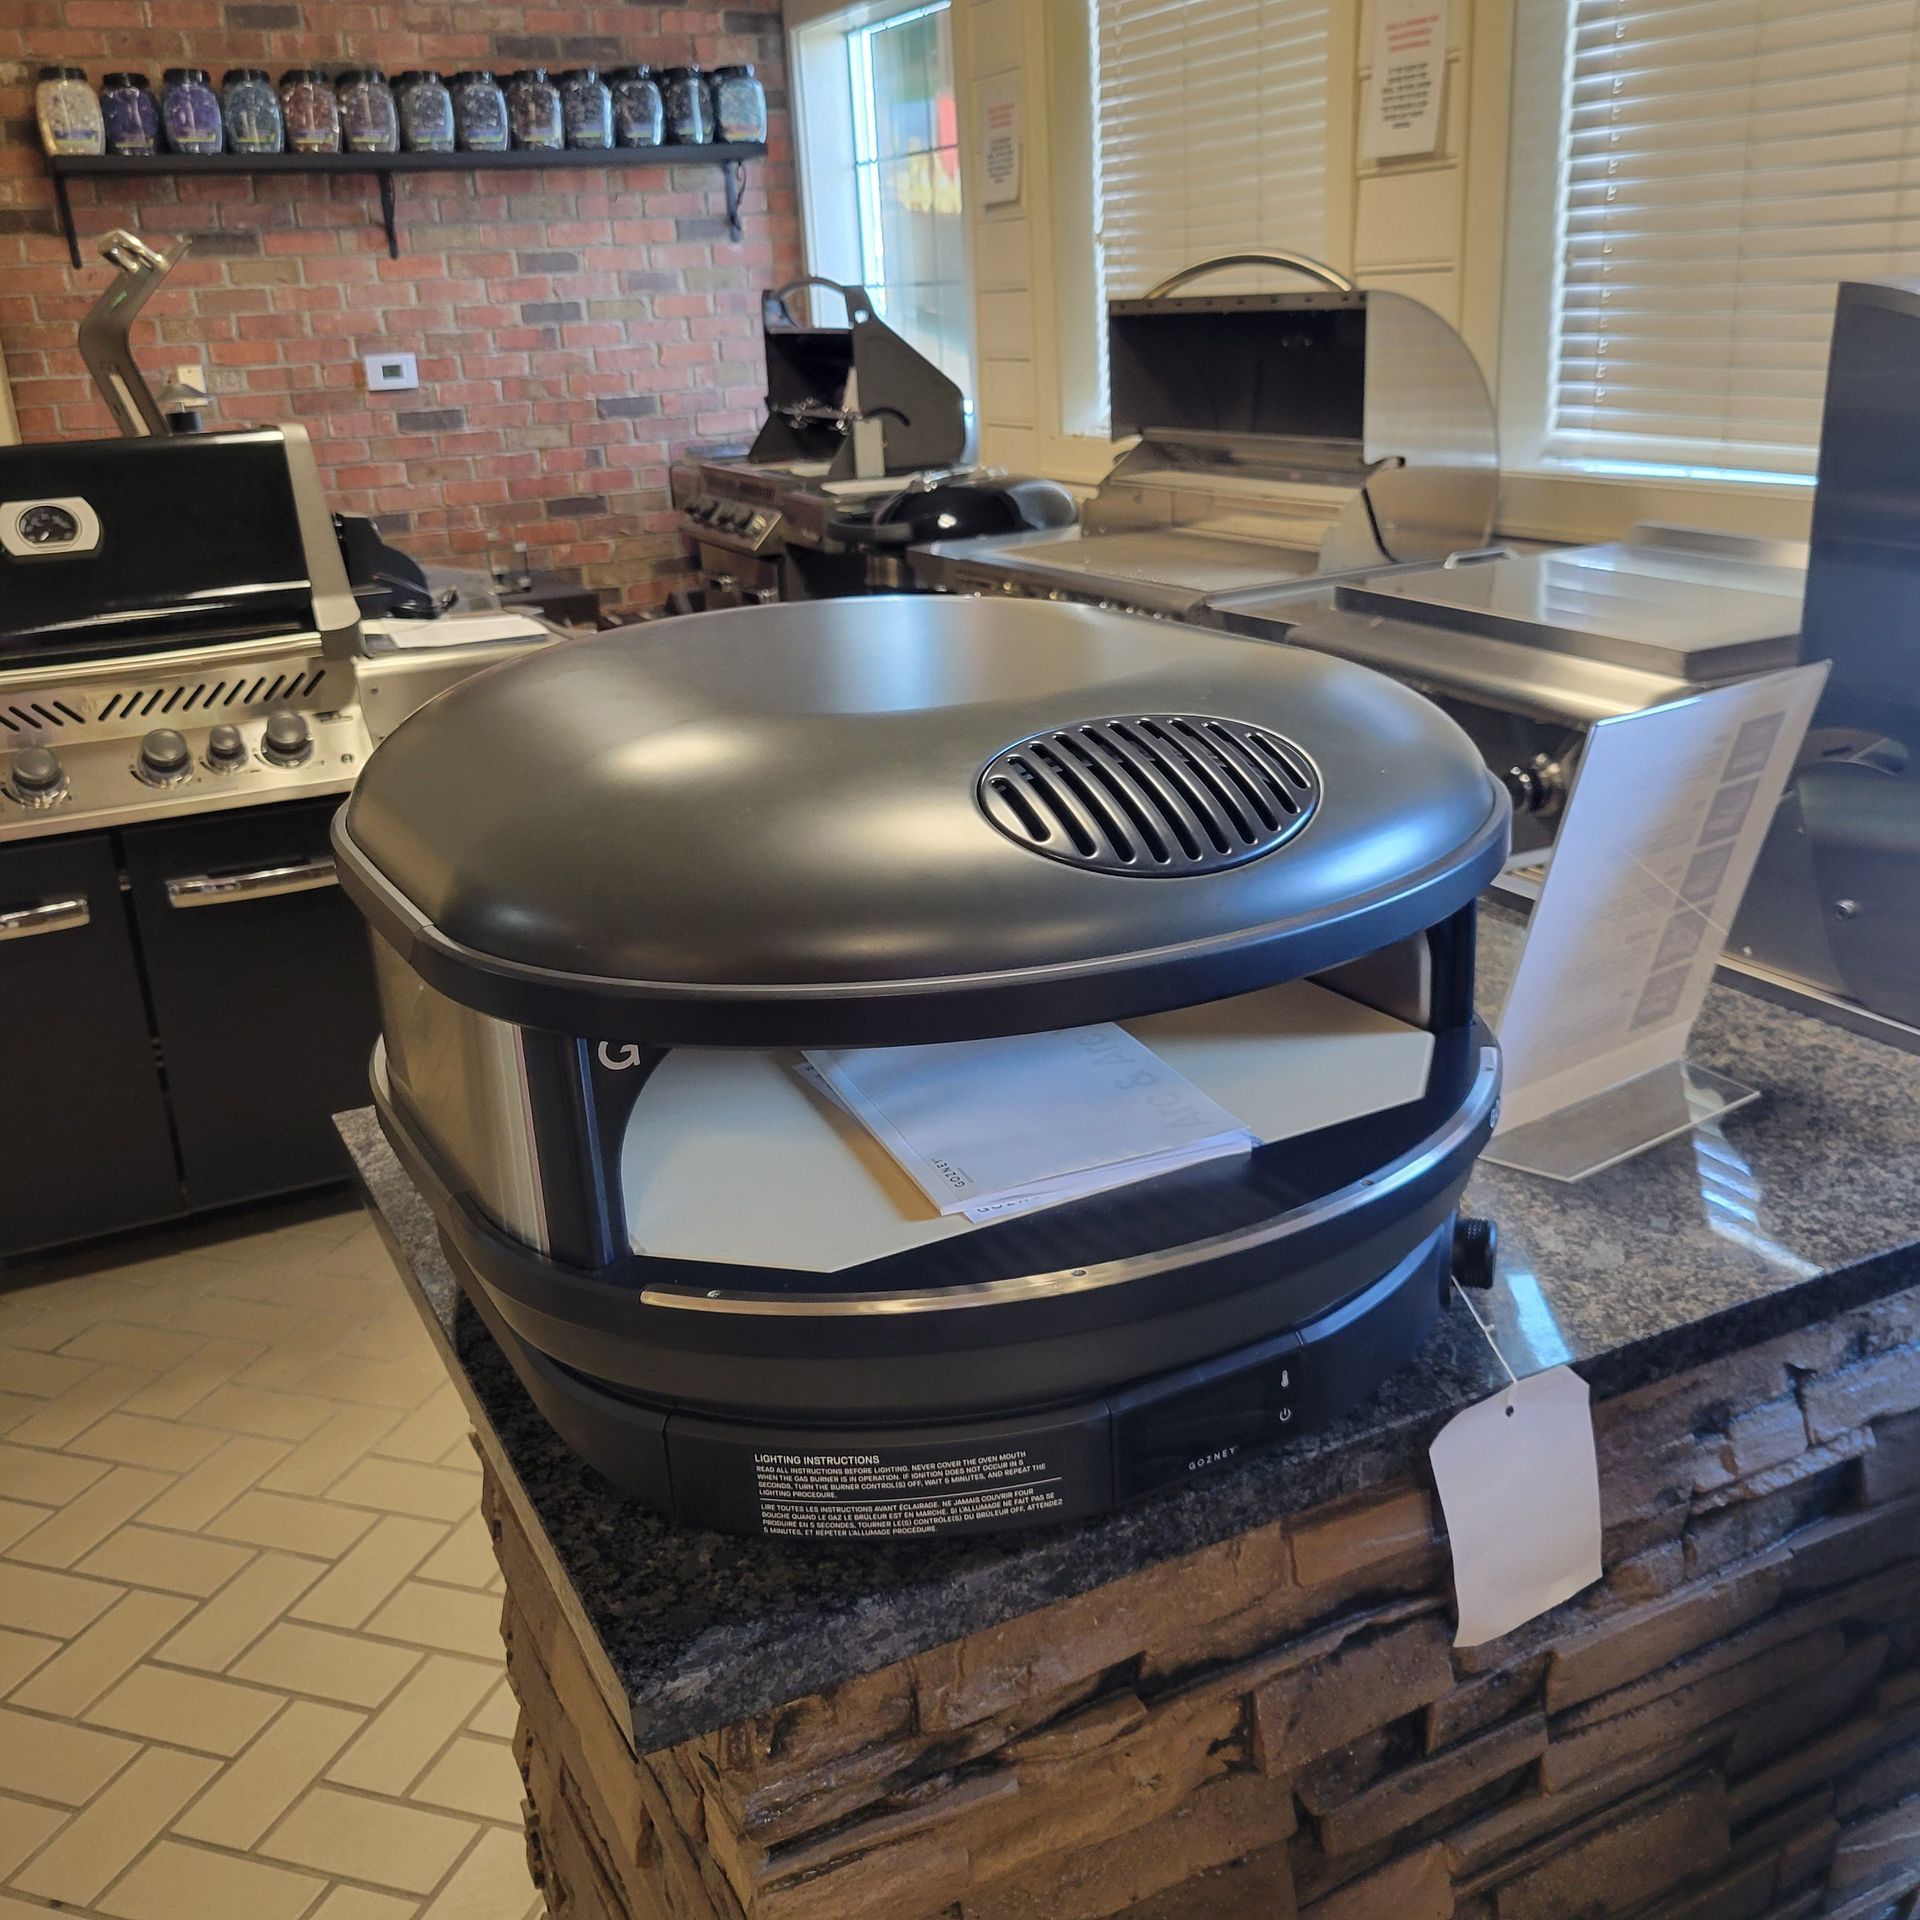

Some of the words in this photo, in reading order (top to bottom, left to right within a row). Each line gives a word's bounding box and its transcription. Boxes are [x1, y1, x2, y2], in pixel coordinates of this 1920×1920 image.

[597, 1040, 640, 1070] G
[934, 1158, 965, 1188] GOZNEY
[754, 1454, 800, 1464] LIGHTING
[803, 1455, 880, 1465] INSTRUCTIONS
[911, 1463, 935, 1471] NEVER
[937, 1460, 961, 1469] COVER
[963, 1458, 976, 1466] THE
[978, 1455, 997, 1464] OVEN
[999, 1451, 1026, 1461] MOUTH
[1188, 1446, 1237, 1470] GOZNEY
[861, 1481, 906, 1489] CONTROL(S)
[925, 1478, 942, 1486] WAIT
[1005, 1466, 1031, 1475] REPEAT
[911, 1470, 943, 1479] IGNITION
[945, 1468, 965, 1476] DOES
[966, 1465, 981, 1473] NOT
[983, 1461, 1008, 1471] OCCUR
[759, 1489, 791, 1497] LIGHTING
[777, 1504, 804, 1512] TOUTES
[954, 1496, 980, 1506] JAMAIS
[981, 1492, 1013, 1502] COUVRIR
[1014, 1488, 1034, 1497] FOUR
[1014, 1497, 1029, 1505] FAIT
[1031, 1494, 1044, 1502] PAS
[763, 1519, 797, 1527] PRODUIRE
